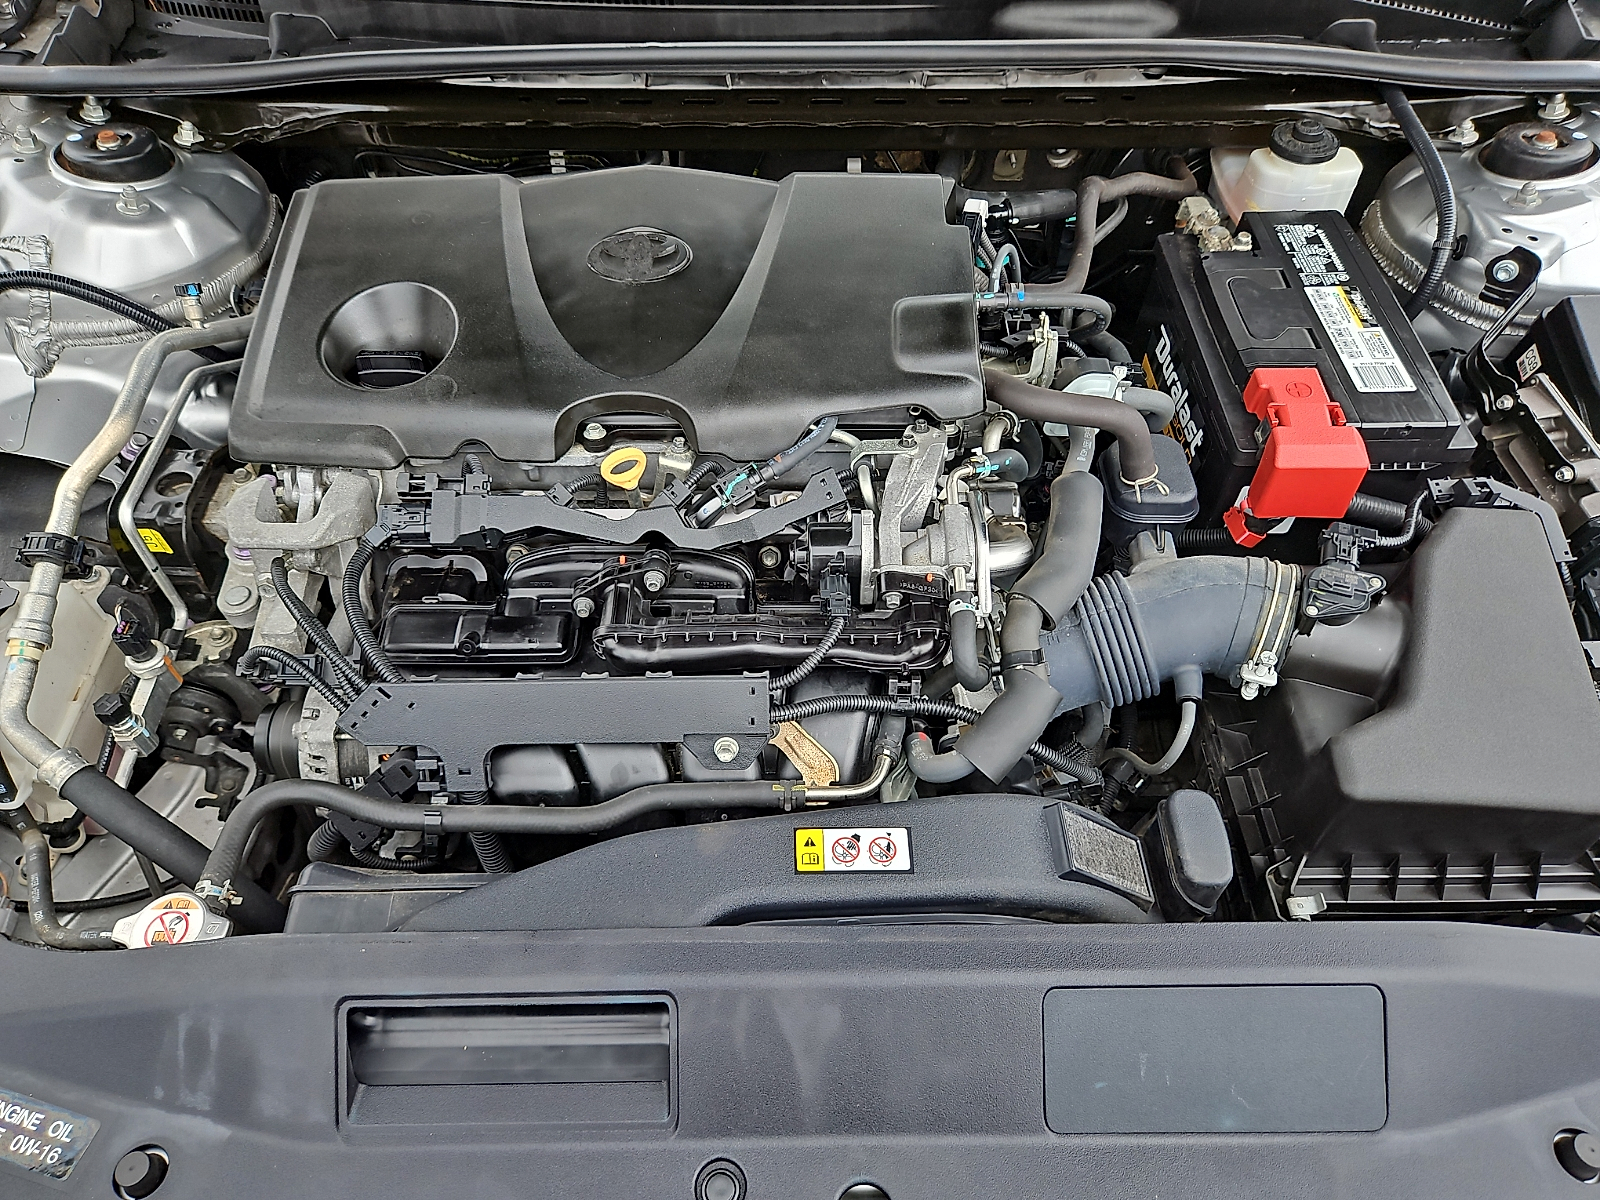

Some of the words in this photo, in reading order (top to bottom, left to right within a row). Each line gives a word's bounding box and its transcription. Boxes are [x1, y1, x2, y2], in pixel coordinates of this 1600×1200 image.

[1155, 324, 1203, 457] Duralast
[0, 1101, 45, 1131] NGINE
[48, 1120, 74, 1142] OIL
[10, 1134, 62, 1164] 0W-16
